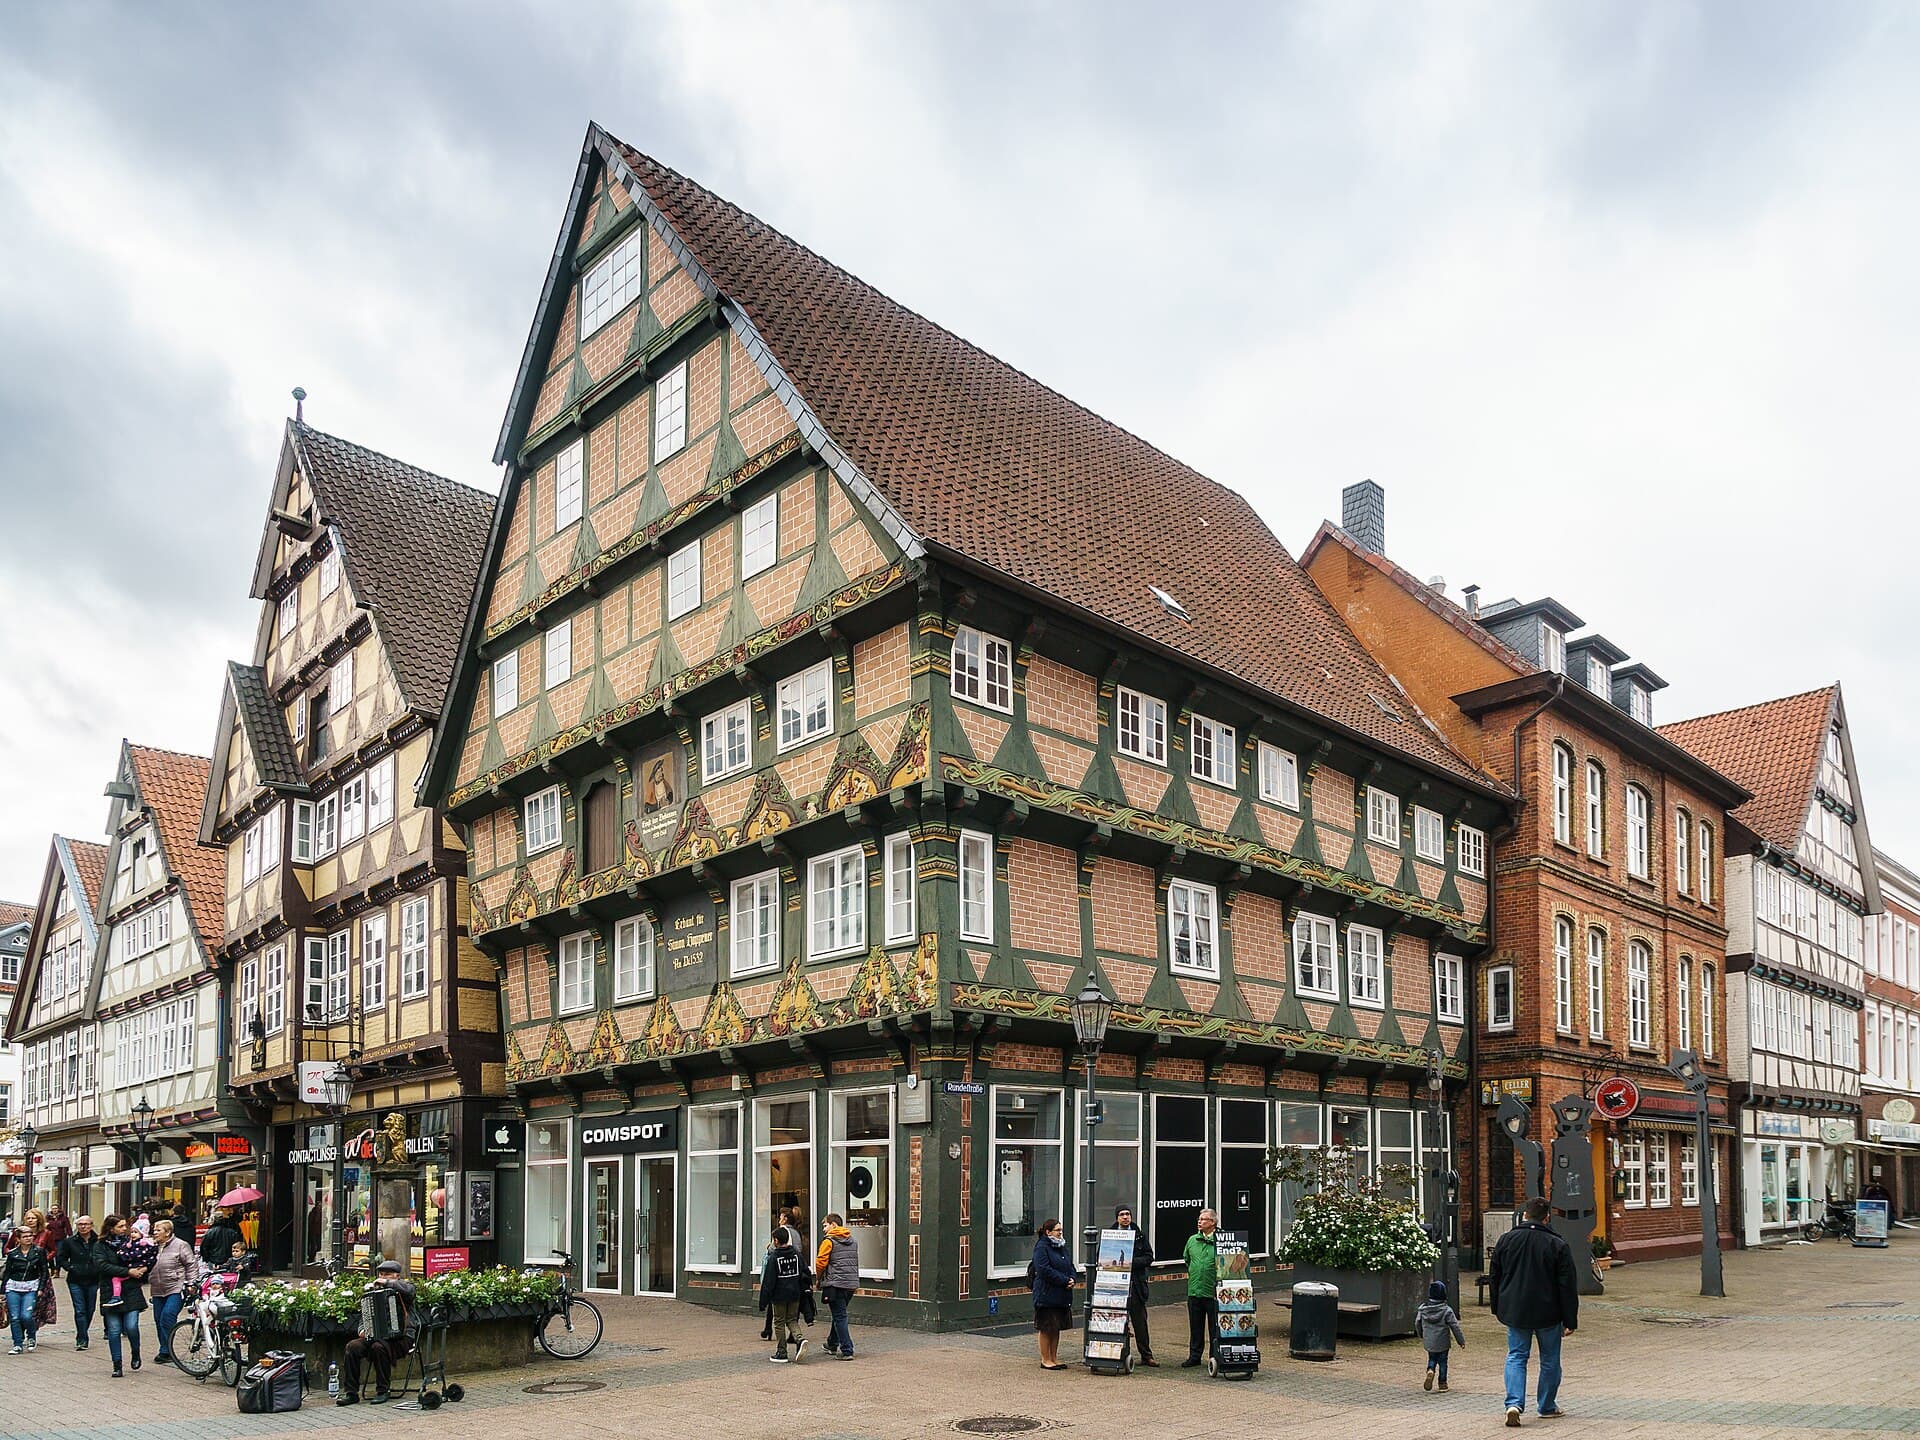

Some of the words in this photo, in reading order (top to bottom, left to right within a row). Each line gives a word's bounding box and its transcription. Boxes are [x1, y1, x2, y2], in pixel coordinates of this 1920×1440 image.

[1504, 1080, 1530, 1090] CELLER
[582, 1123, 664, 1144] COMSPOT
[404, 1136, 434, 1154] RILLEN
[1157, 1199, 1203, 1209] COMSPOT
[1215, 1233, 1234, 1241] Will
[1216, 1246, 1241, 1255] End?
